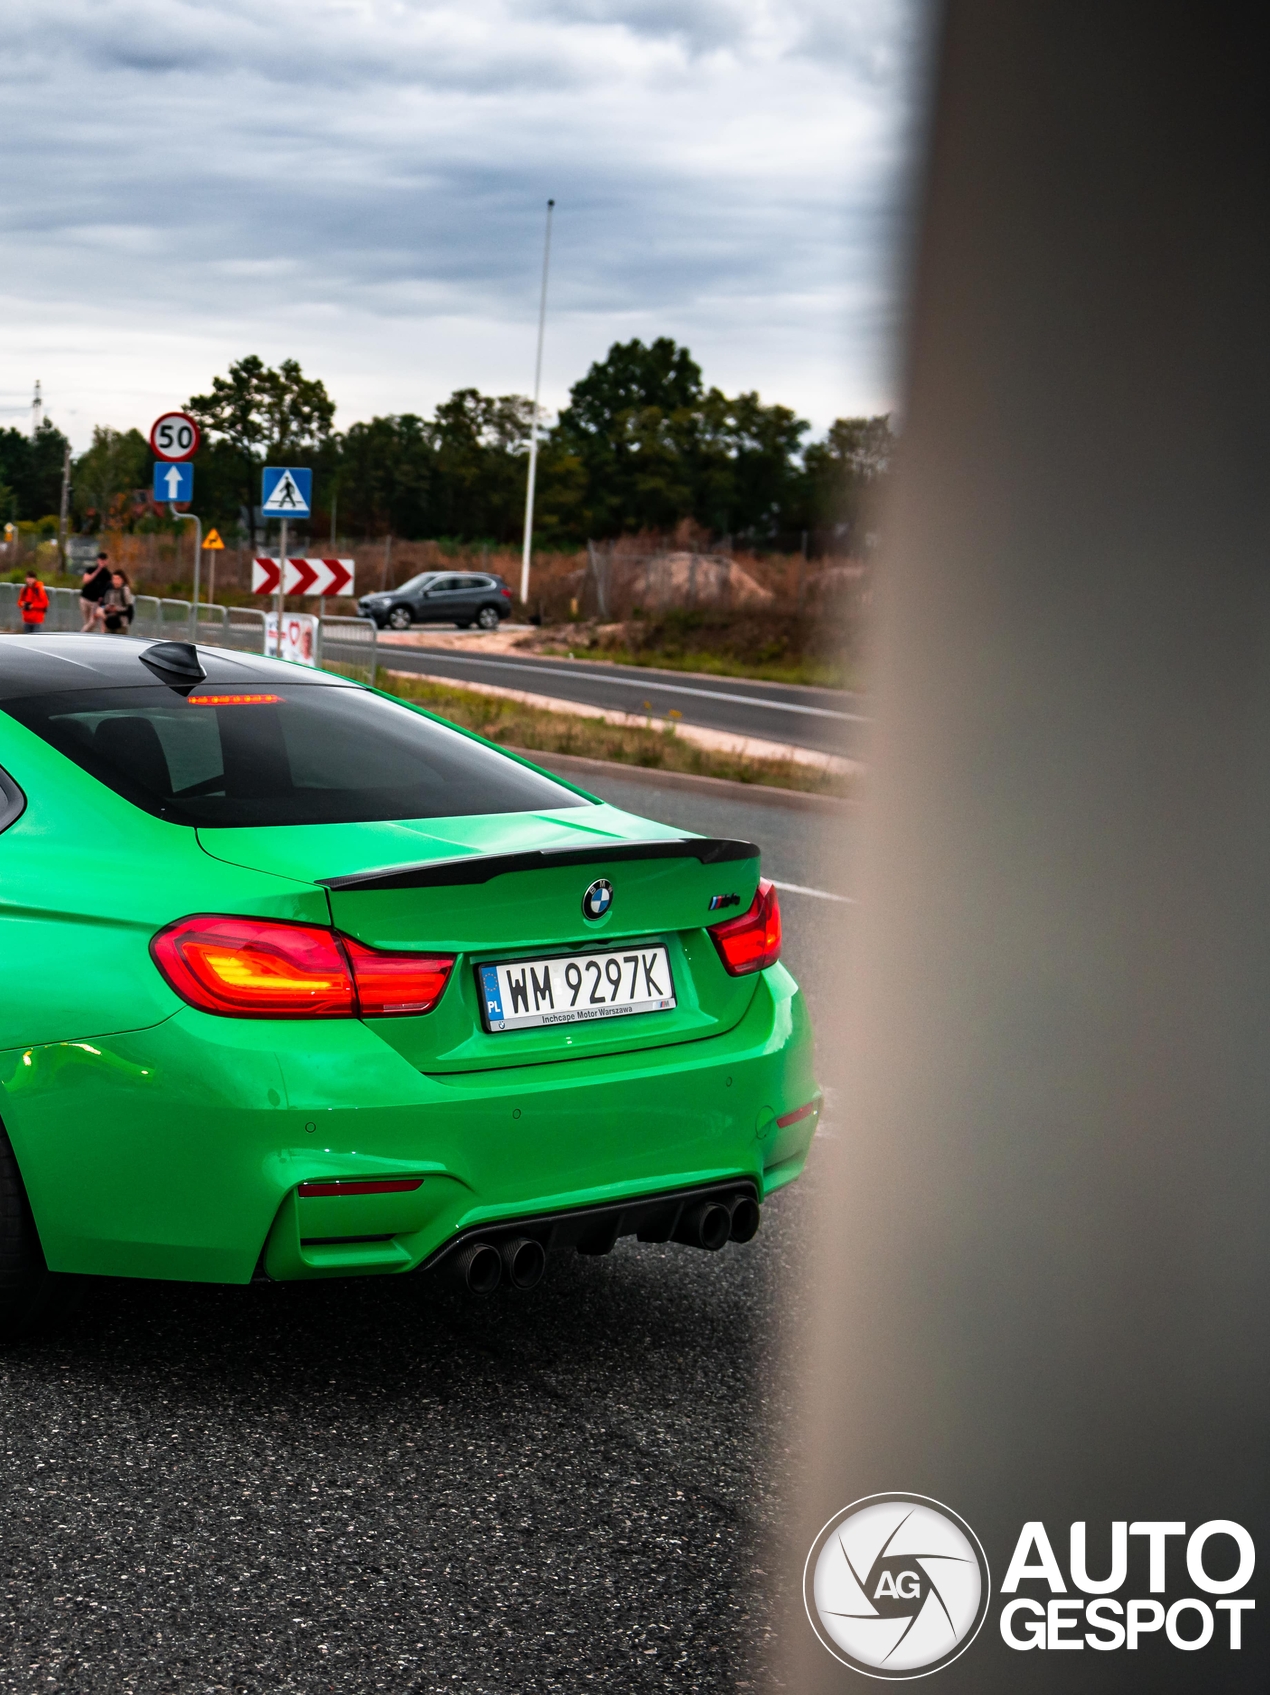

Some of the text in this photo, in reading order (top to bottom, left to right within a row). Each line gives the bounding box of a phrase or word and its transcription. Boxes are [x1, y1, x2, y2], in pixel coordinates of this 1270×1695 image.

[159, 425, 192, 449] 50
[506, 953, 664, 1014] WM 9297K
[487, 1001, 502, 1014] PL
[542, 1006, 633, 1024] Inchcape Motor Warszawa
